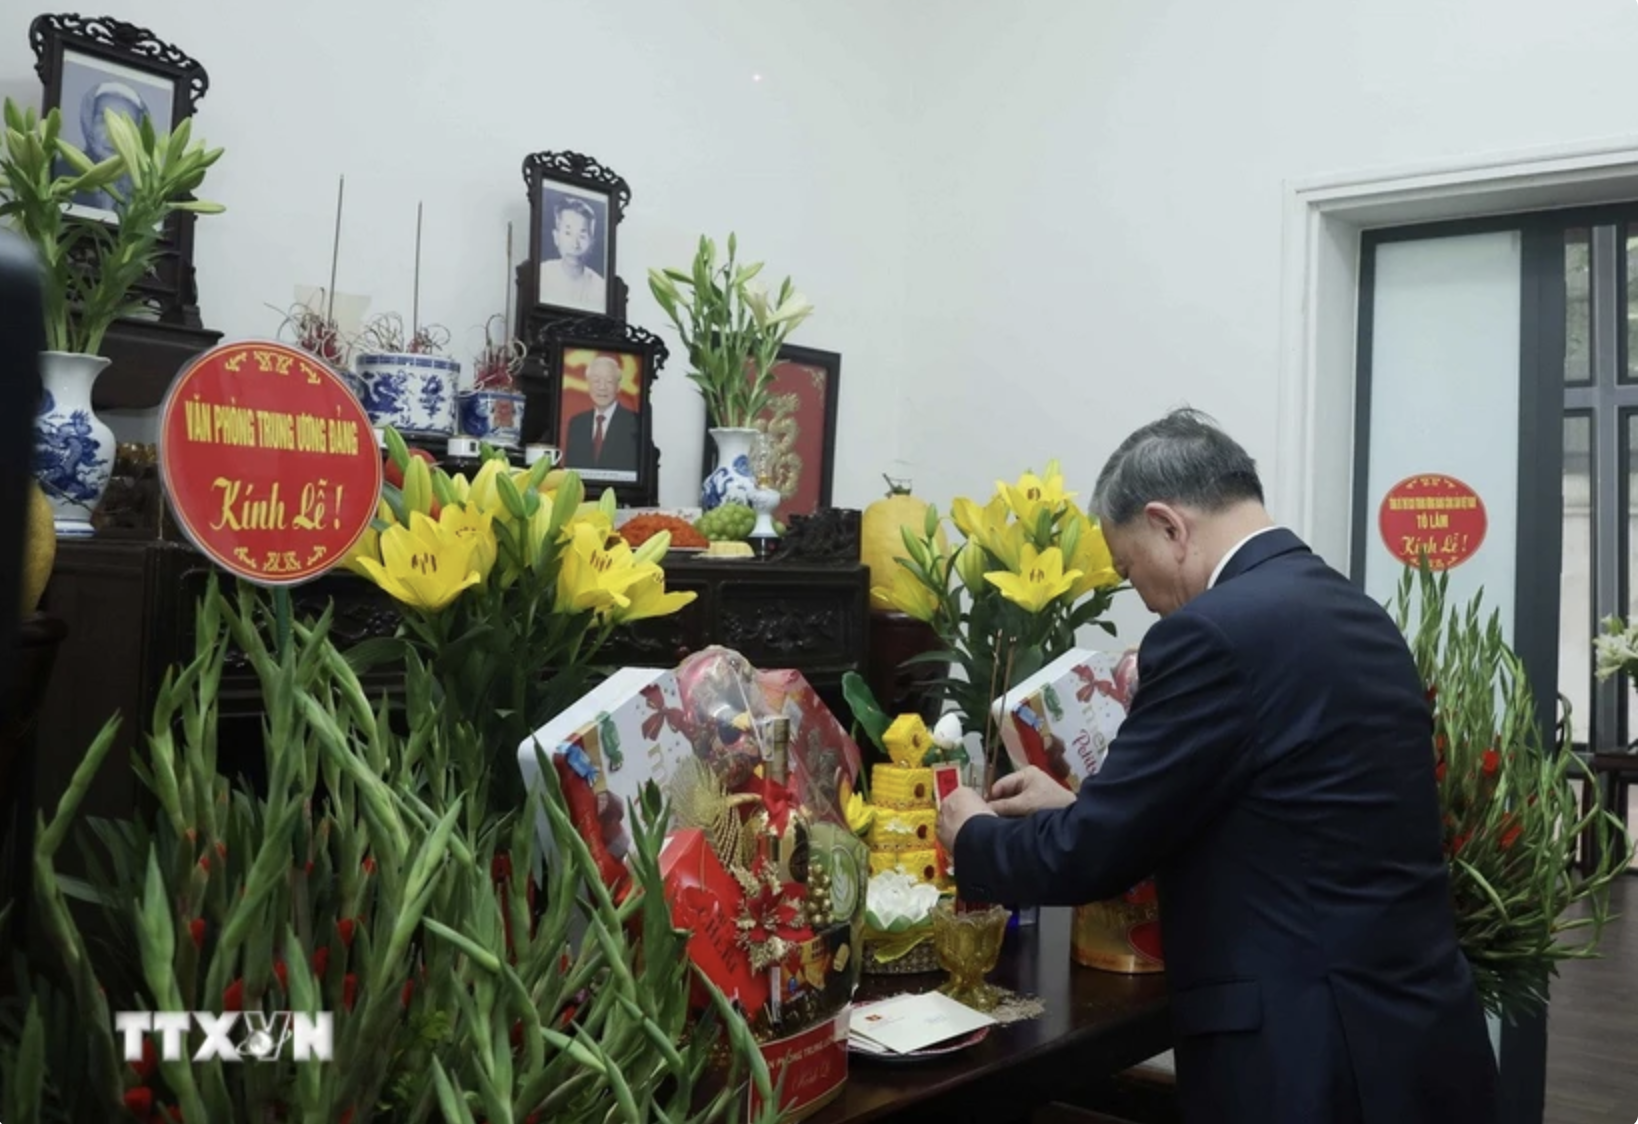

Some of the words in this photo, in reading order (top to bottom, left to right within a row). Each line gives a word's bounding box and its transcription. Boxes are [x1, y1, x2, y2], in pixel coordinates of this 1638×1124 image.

[185, 394, 213, 443] VĂN
[214, 397, 255, 448] PHÒNG
[256, 411, 295, 450] TRUNG
[296, 411, 327, 454] ƯƠNG
[328, 404, 359, 456] ĐẢNG
[209, 476, 286, 532] Kính
[292, 478, 327, 531] Lễ
